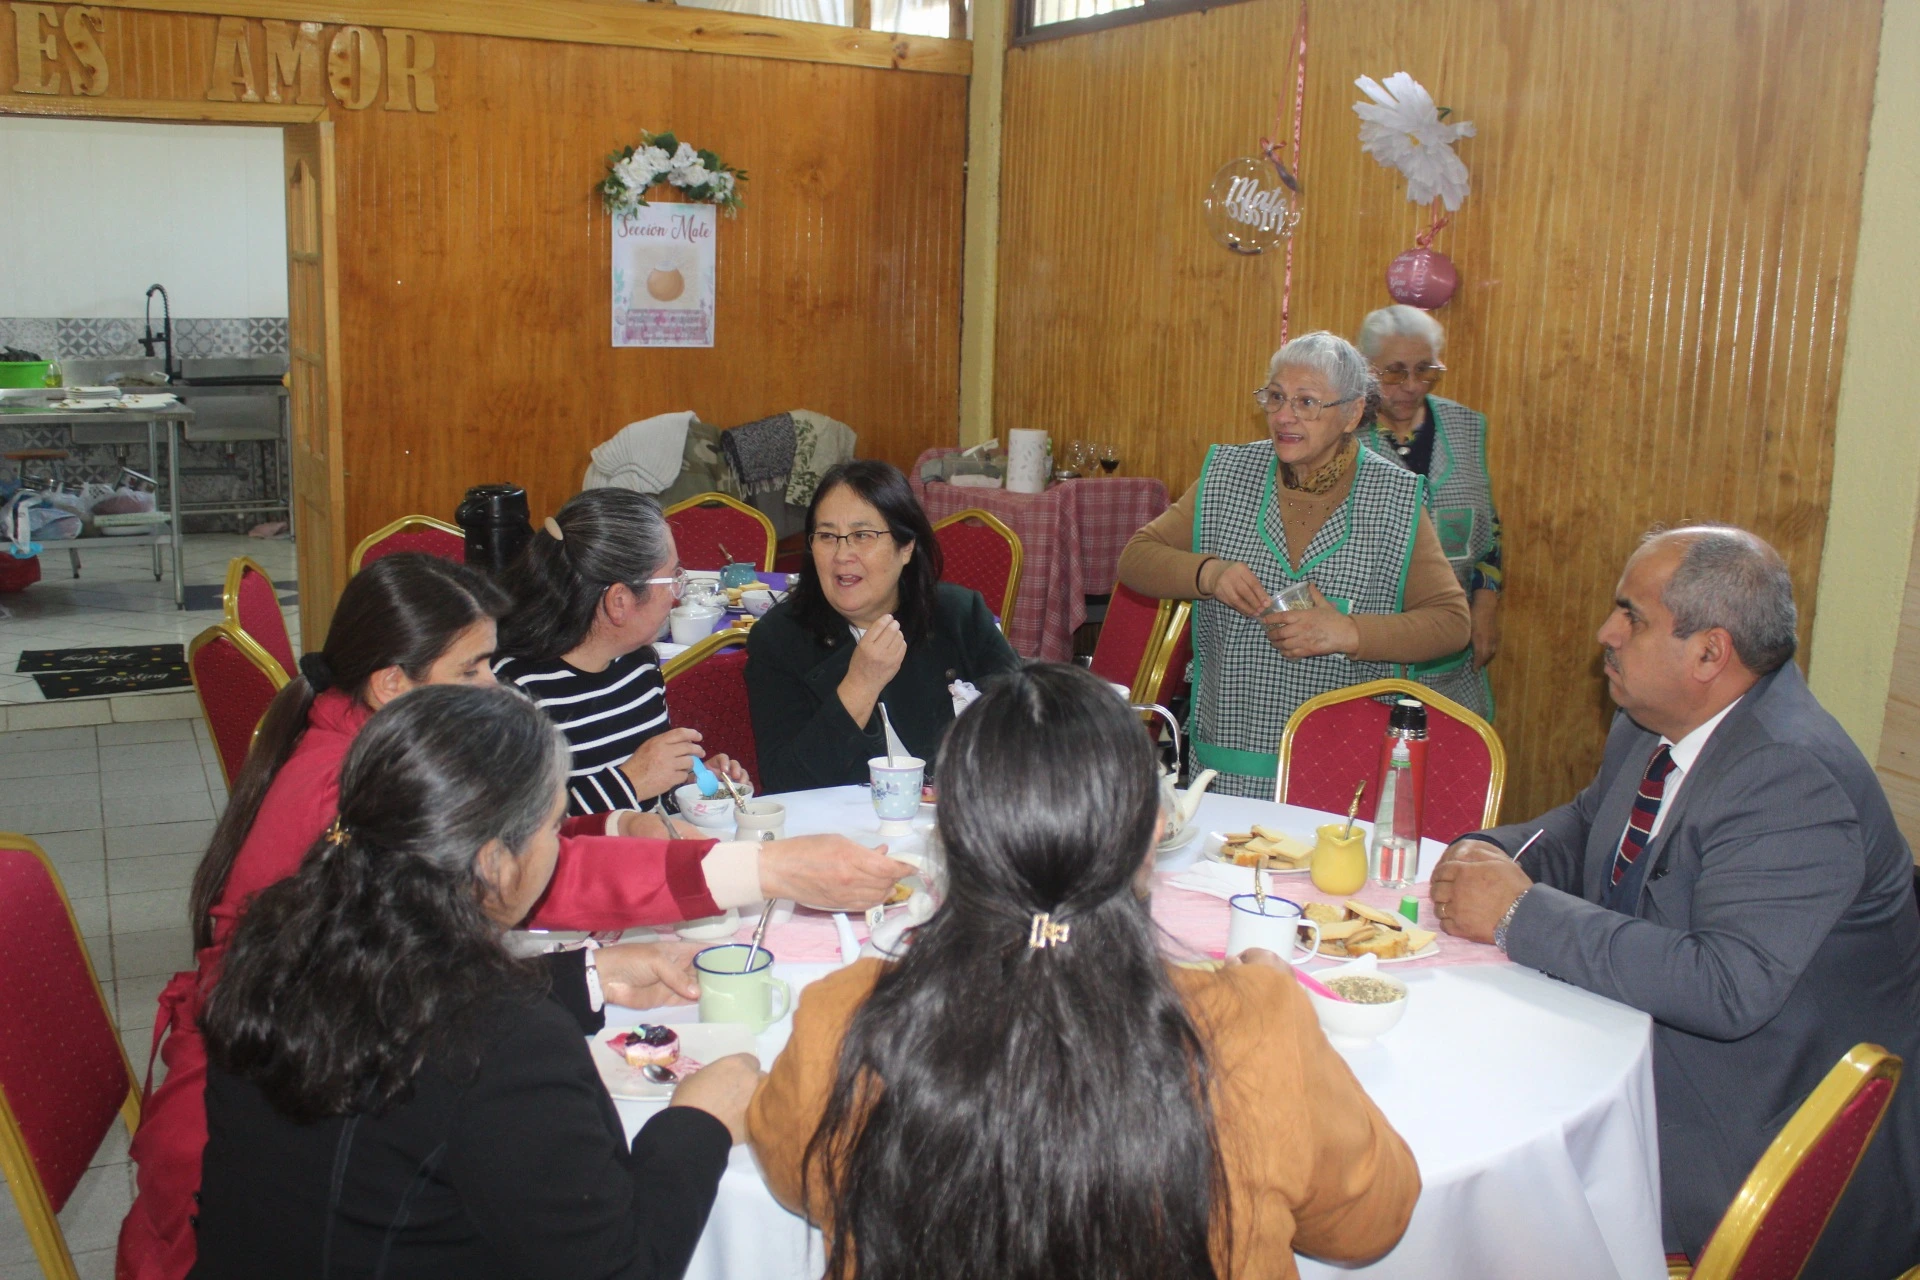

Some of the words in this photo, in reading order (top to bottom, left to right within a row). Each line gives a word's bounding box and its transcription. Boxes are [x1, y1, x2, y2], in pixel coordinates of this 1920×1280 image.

[12, 2, 110, 96] ES
[207, 15, 440, 112] AMOR
[1225, 175, 1287, 214] Mate
[671, 214, 711, 243] Mate
